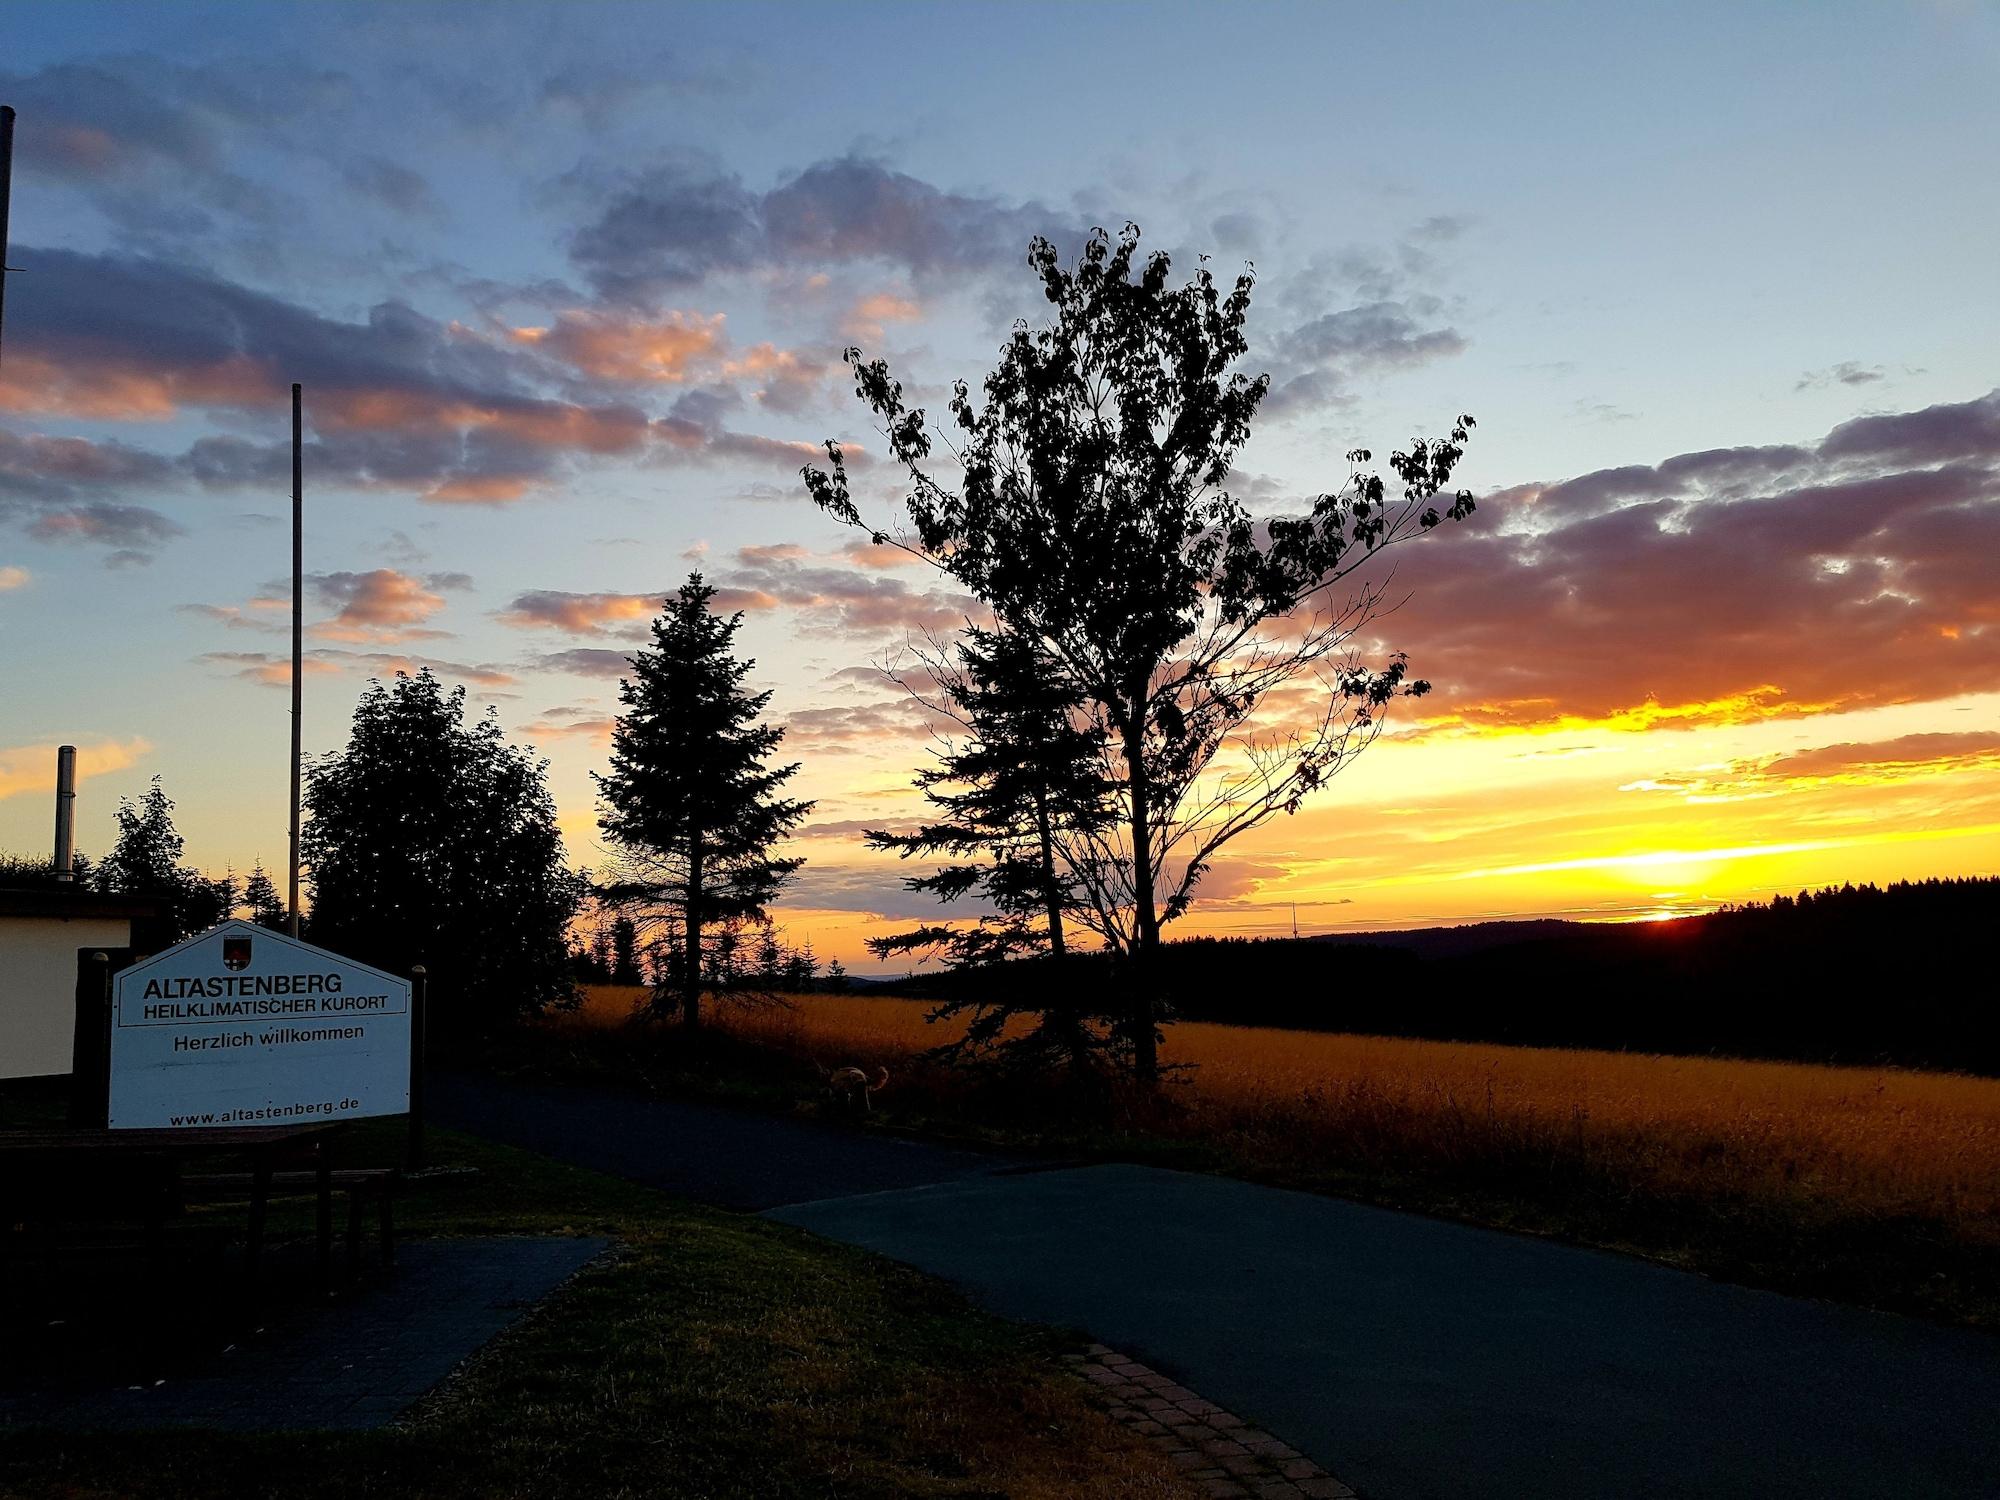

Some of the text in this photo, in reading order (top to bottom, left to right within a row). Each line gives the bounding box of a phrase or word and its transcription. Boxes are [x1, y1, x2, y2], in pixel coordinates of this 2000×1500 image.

[143, 973, 342, 999] ALTASTENBERG
[143, 995, 388, 1019] HEILKLIMATISCHER KURORT
[174, 1026, 364, 1051] Herzlich willkommen
[170, 1097, 359, 1126] www.altastenberg.de
